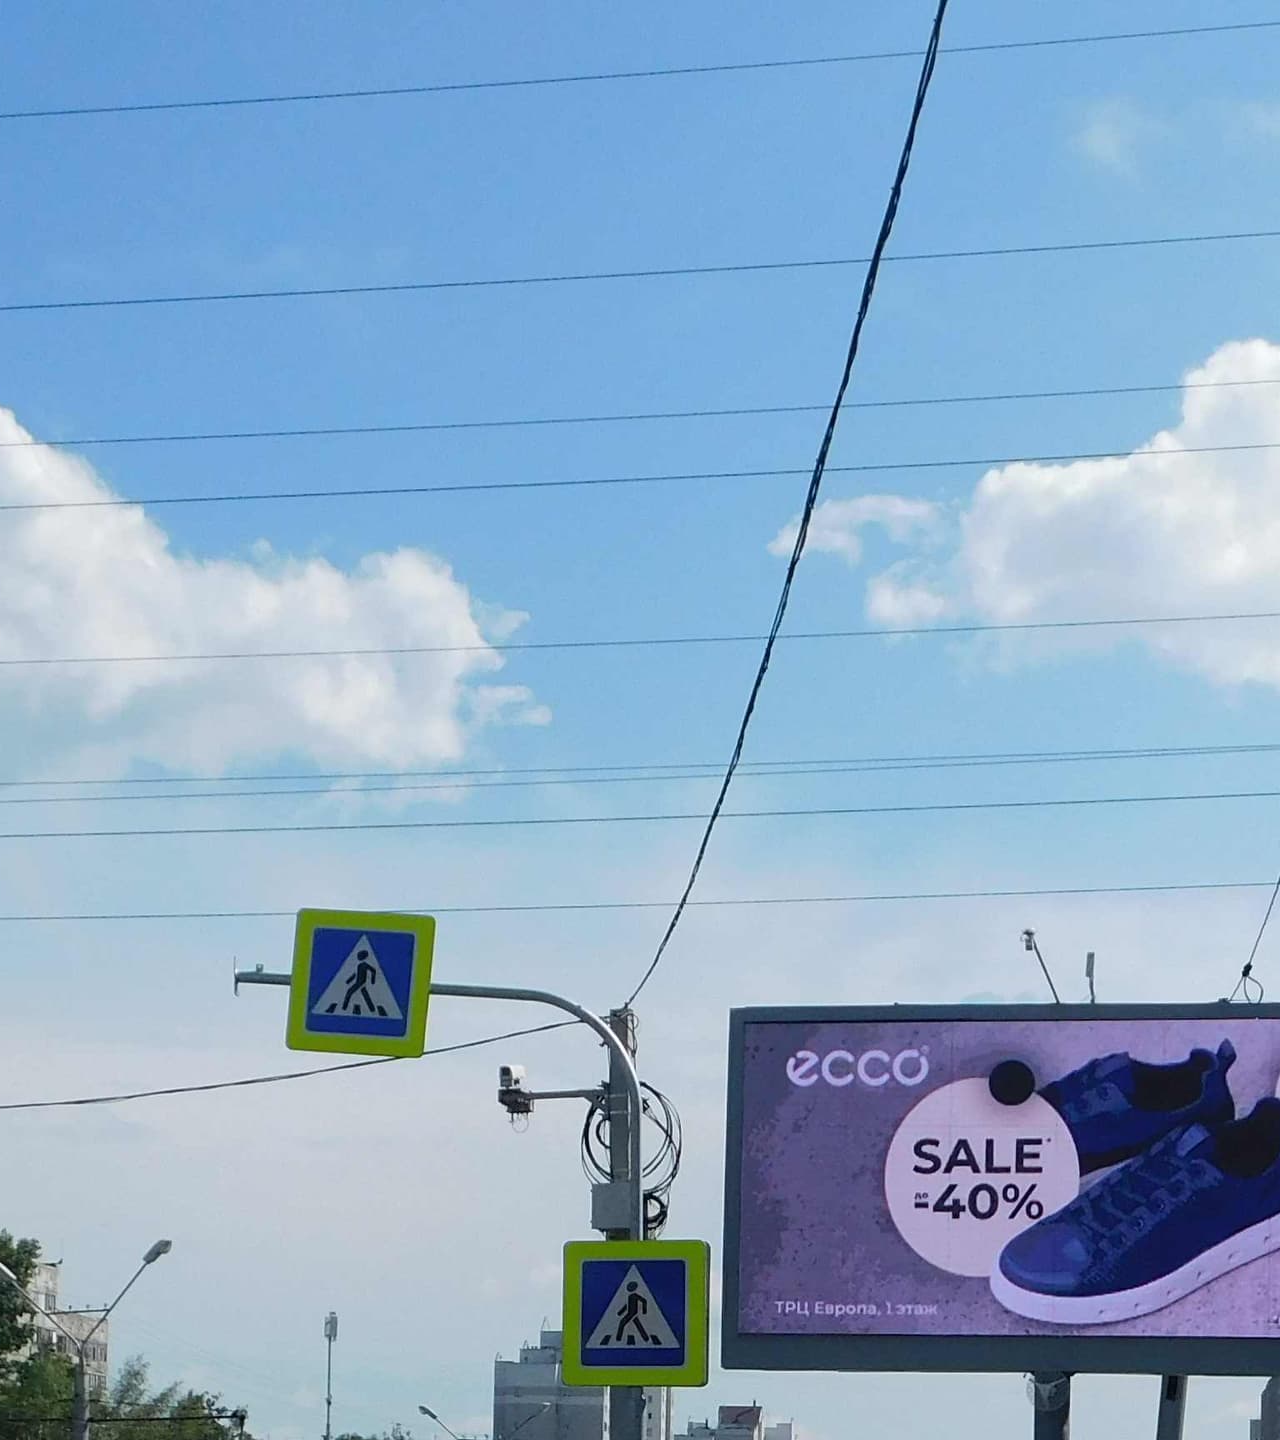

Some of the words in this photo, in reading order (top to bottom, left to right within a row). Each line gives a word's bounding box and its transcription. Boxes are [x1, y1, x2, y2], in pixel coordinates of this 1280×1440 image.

[786, 1049, 929, 1087] ecco
[774, 1301, 810, 1317] ТРЦ
[814, 1301, 882, 1317] Европа,
[895, 1303, 938, 1316] этаж
